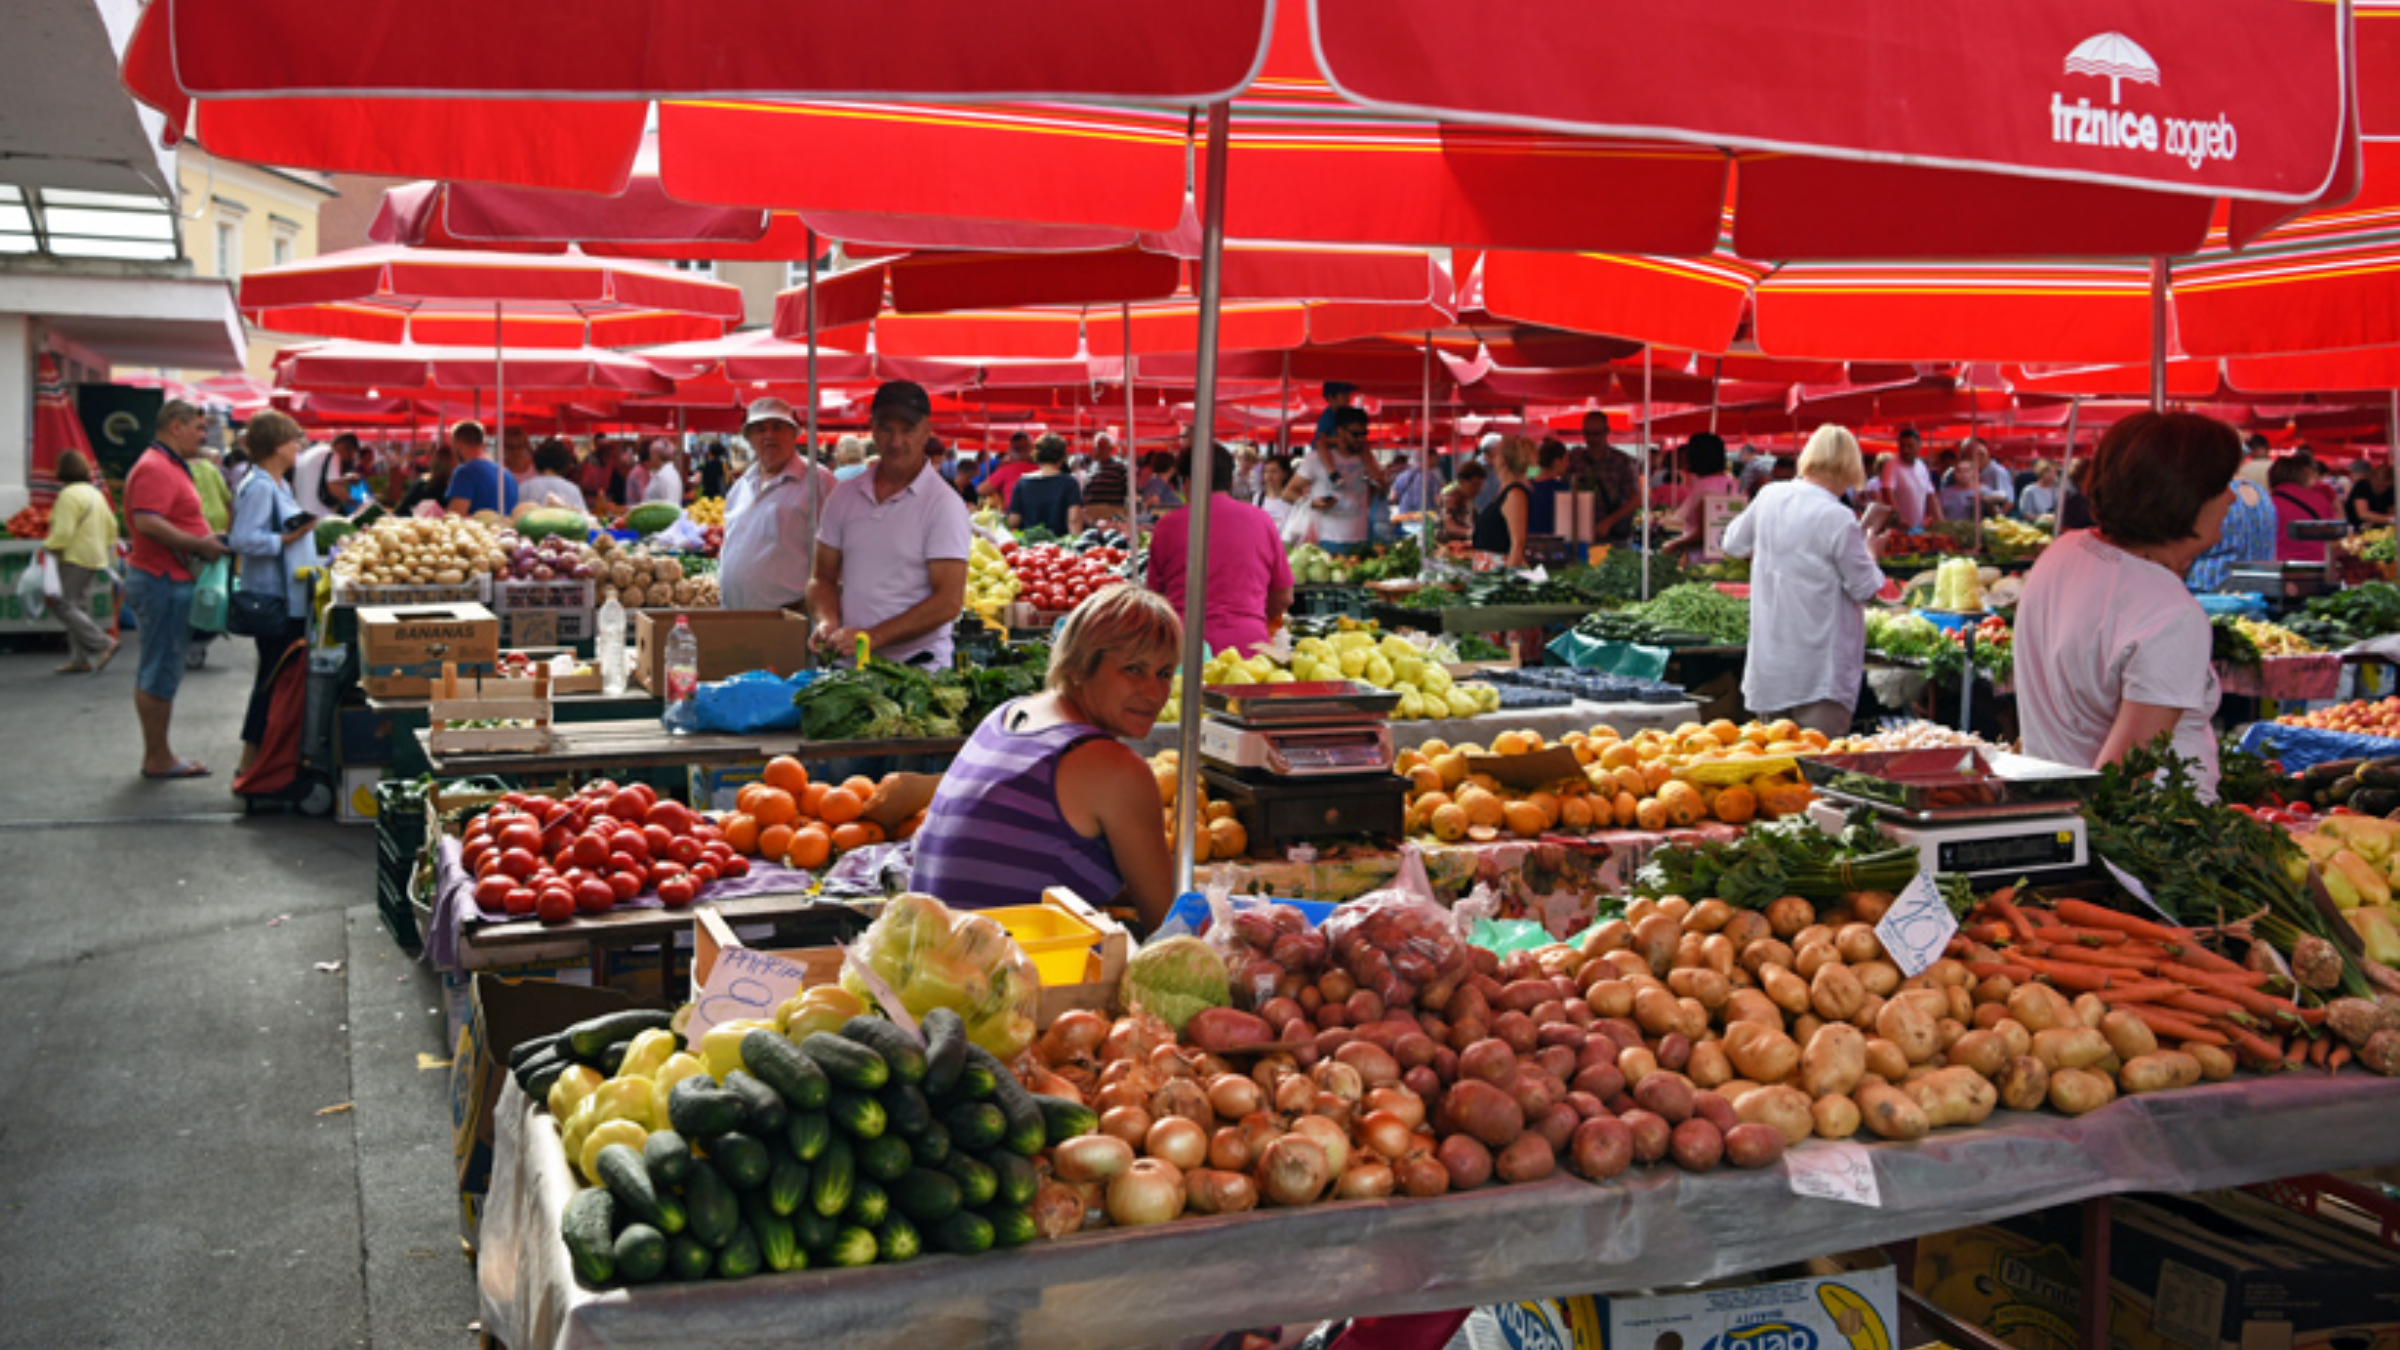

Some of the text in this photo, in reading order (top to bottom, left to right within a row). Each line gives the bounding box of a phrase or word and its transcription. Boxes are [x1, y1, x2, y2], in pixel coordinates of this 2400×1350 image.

[2050, 92, 2237, 170] tržnice zagreb
[395, 625, 476, 640] BANANAS
